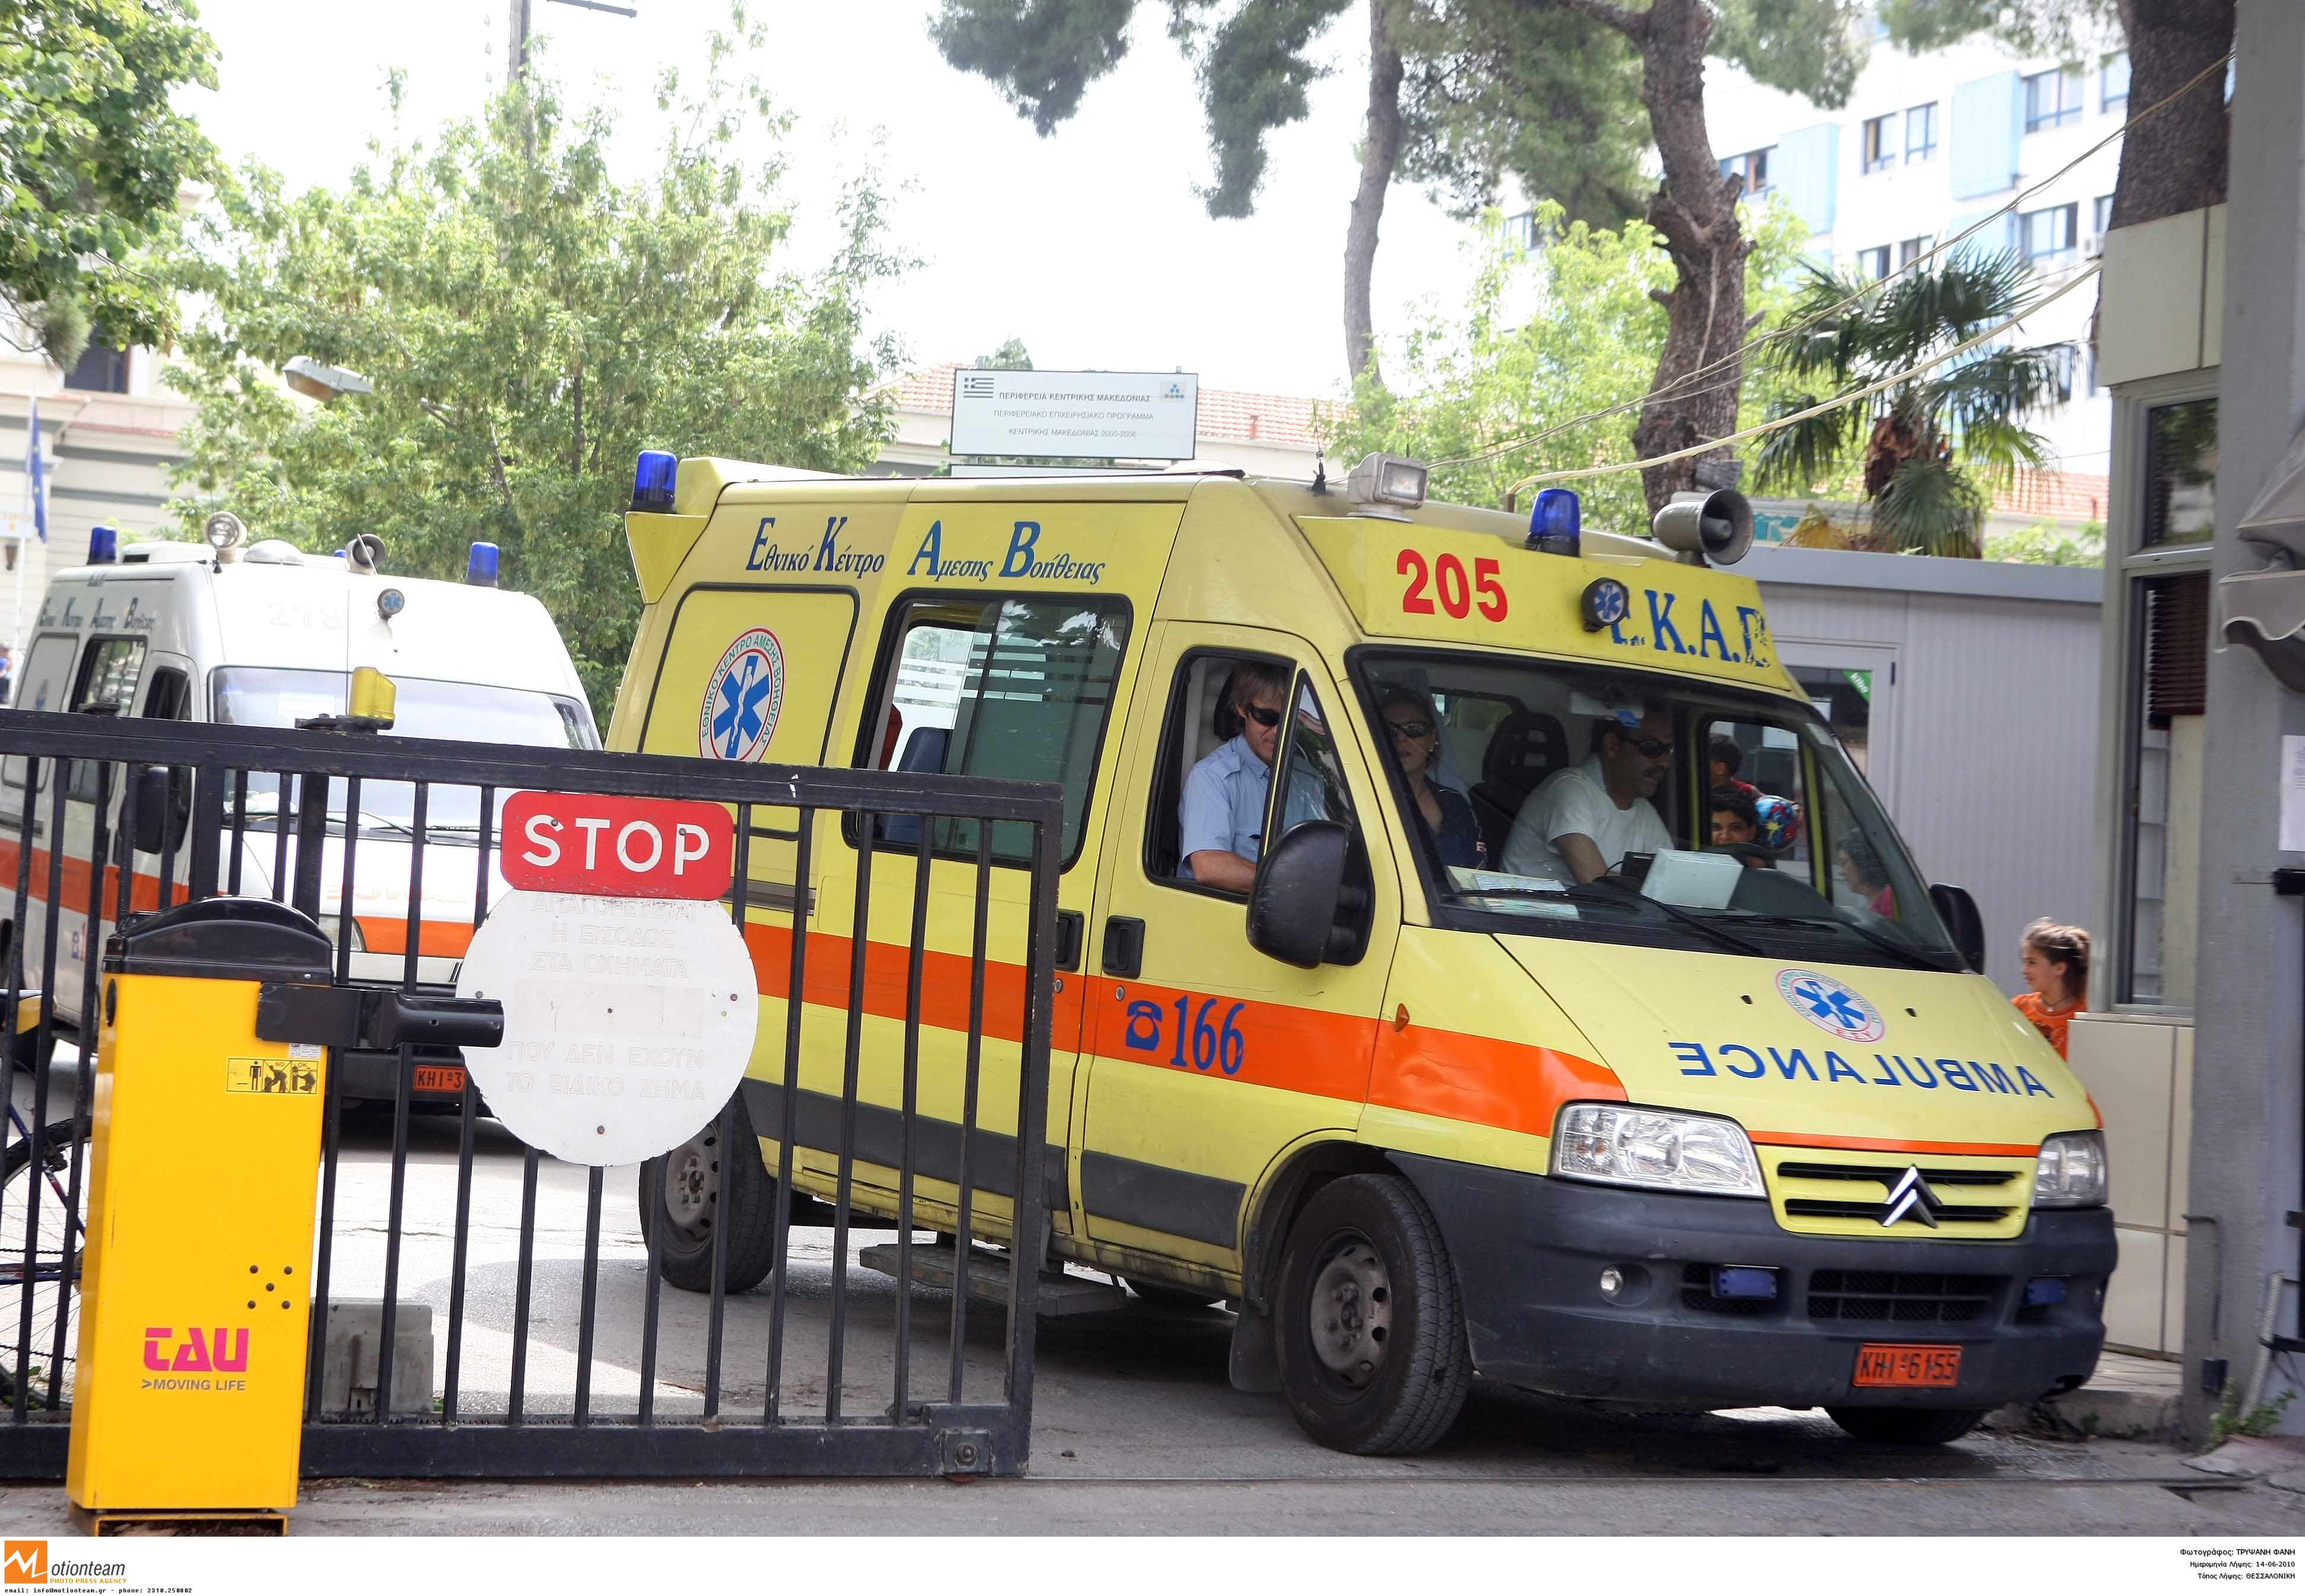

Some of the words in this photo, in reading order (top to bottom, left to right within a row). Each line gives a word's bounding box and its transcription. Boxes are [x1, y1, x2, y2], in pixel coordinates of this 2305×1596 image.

[999, 392, 1047, 401] ΠΕΡΙΦΕΡΕΙΑ
[1049, 393, 1095, 401] ΚΕΝΤΡΙΚΗΣ
[1097, 394, 1151, 403] ΜΑΚΕΔΟΝΙΑΣ
[994, 410, 1047, 419] ΠΕΡΙΦΕΡΕΙΑΚΟ
[1107, 412, 1153, 420] ΠΡΟΓΡΑΜΜΑ
[1008, 428, 1049, 436] ΚΕΝΤΡΙΚΗΣ
[1051, 429, 1099, 438] ΜΑΚΕΔΟΝΙΑΣ
[1101, 430, 1137, 438] 2000-2006
[746, 517, 815, 572] Εθνικό
[813, 516, 885, 579] Κέντρο
[907, 520, 994, 582] Αμεσης
[999, 521, 1105, 585] Βοήθειας
[1397, 548, 1508, 623] 205
[718, 636, 752, 676] ΚΕΝΤΡΟ
[522, 814, 710, 876] STOP
[579, 924, 674, 949] ΕΙΣΟΔΟΣ
[583, 953, 688, 978] ΟΧΗΜΑΤΑ
[1170, 995, 1246, 1075] 166
[565, 1043, 614, 1065] ΔΕΝ
[628, 1046, 704, 1068] ΕΧΟΥΝ
[550, 1074, 625, 1097] ΕΙΔΙΚΟ
[640, 1078, 707, 1100] ΣΗΜΑ
[216, 1380, 246, 1391] LIFE
